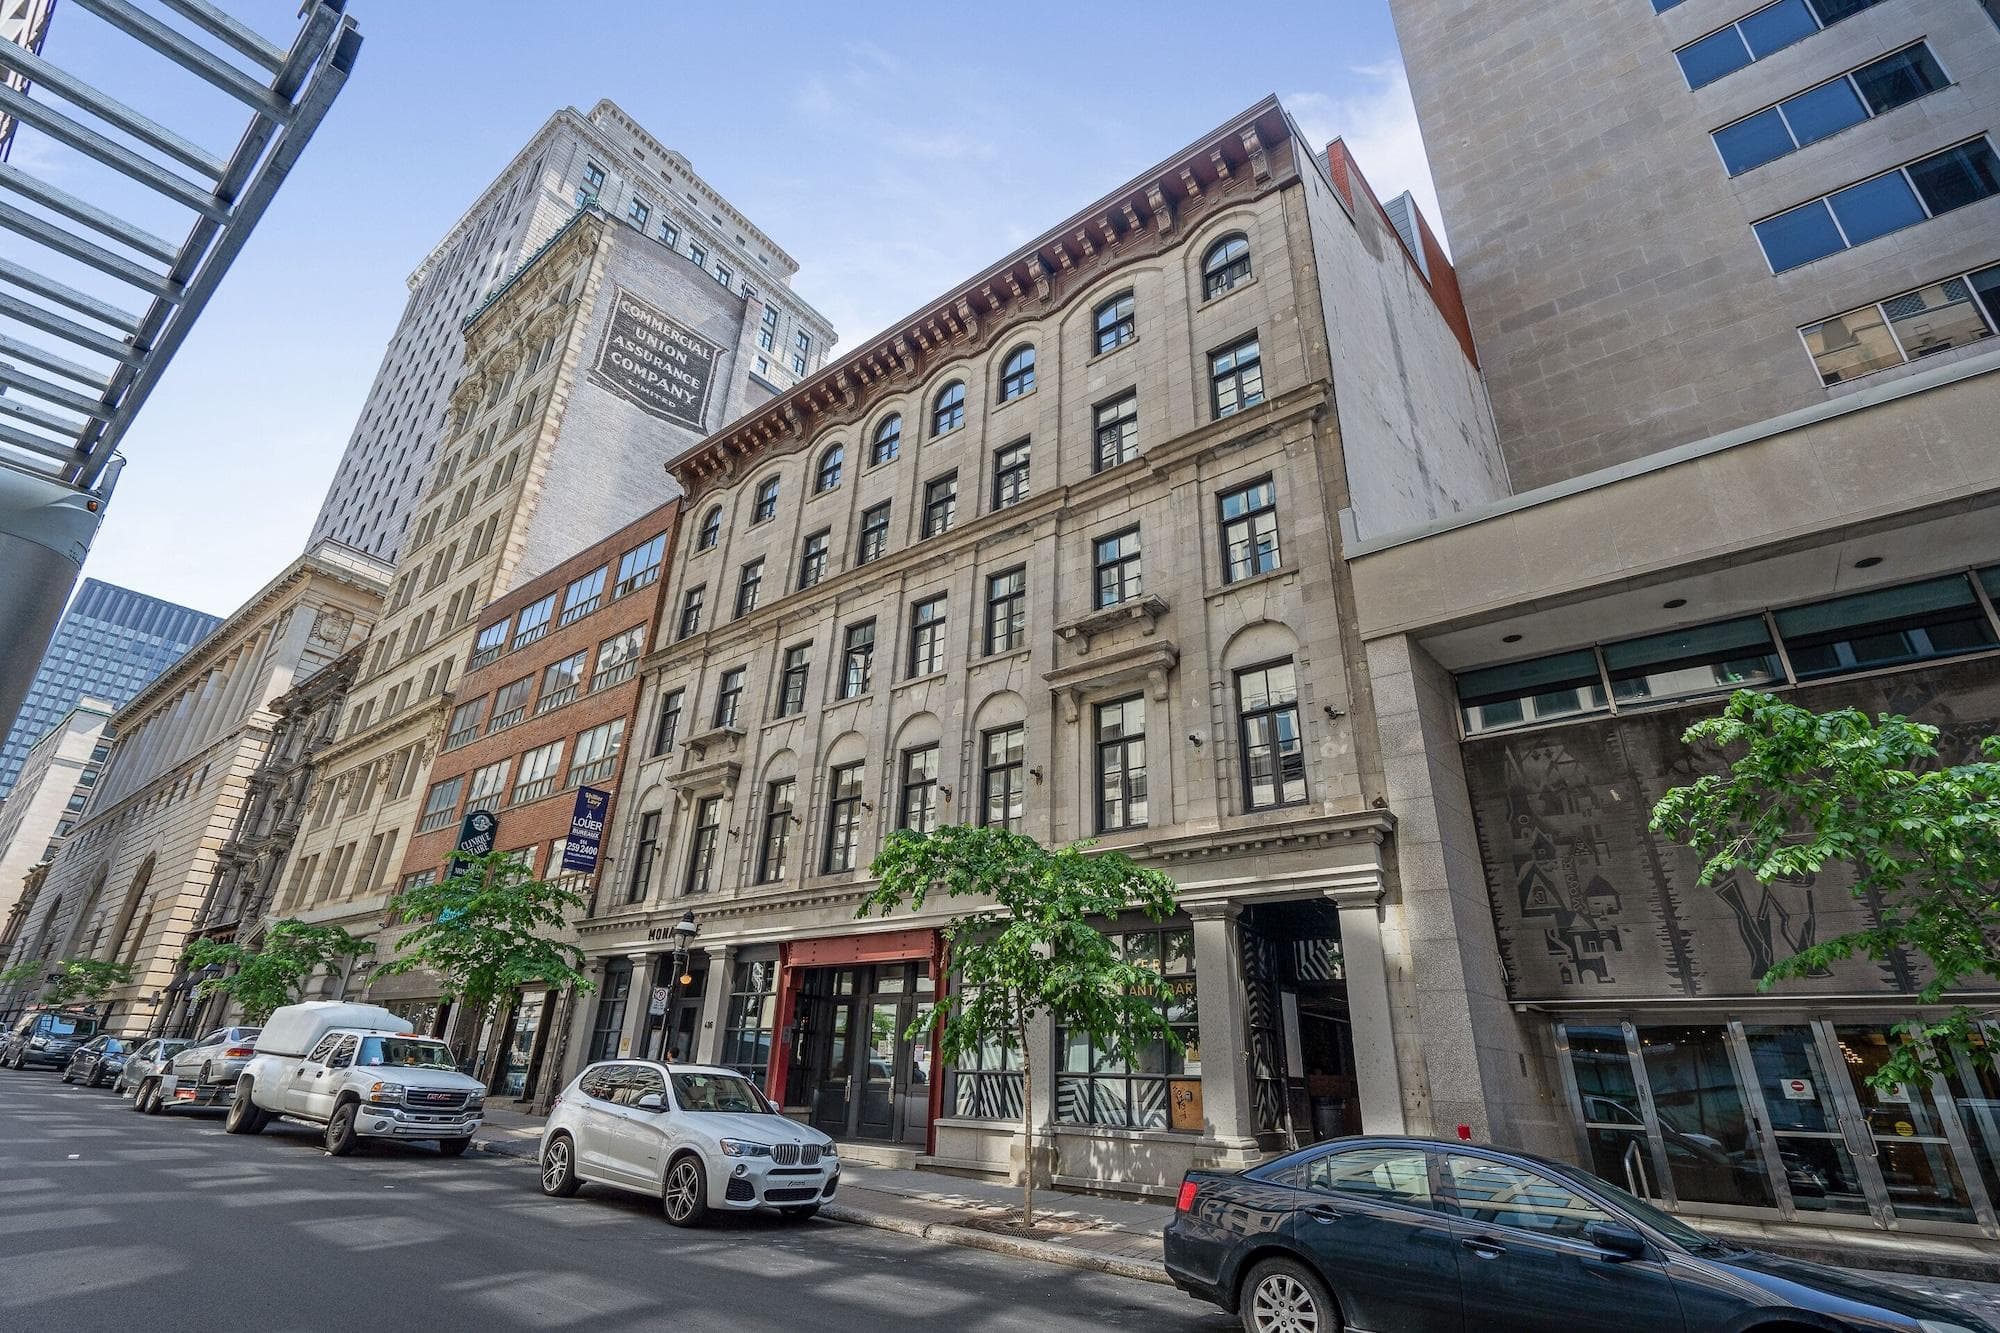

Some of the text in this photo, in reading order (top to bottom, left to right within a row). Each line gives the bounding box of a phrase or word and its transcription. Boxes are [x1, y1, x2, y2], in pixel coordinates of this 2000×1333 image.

[620, 300, 713, 361] COMMERCIAL
[635, 327, 688, 365] UNION
[613, 335, 701, 389] ASSURANCE
[611, 351, 697, 405] COMPANY
[628, 380, 677, 408] LIMITED
[572, 828, 600, 839] BUREAUX
[573, 816, 603, 832] LOUER
[461, 831, 491, 851] CLINIQUE
[567, 842, 580, 853] 259
[580, 845, 598, 856] 2400
